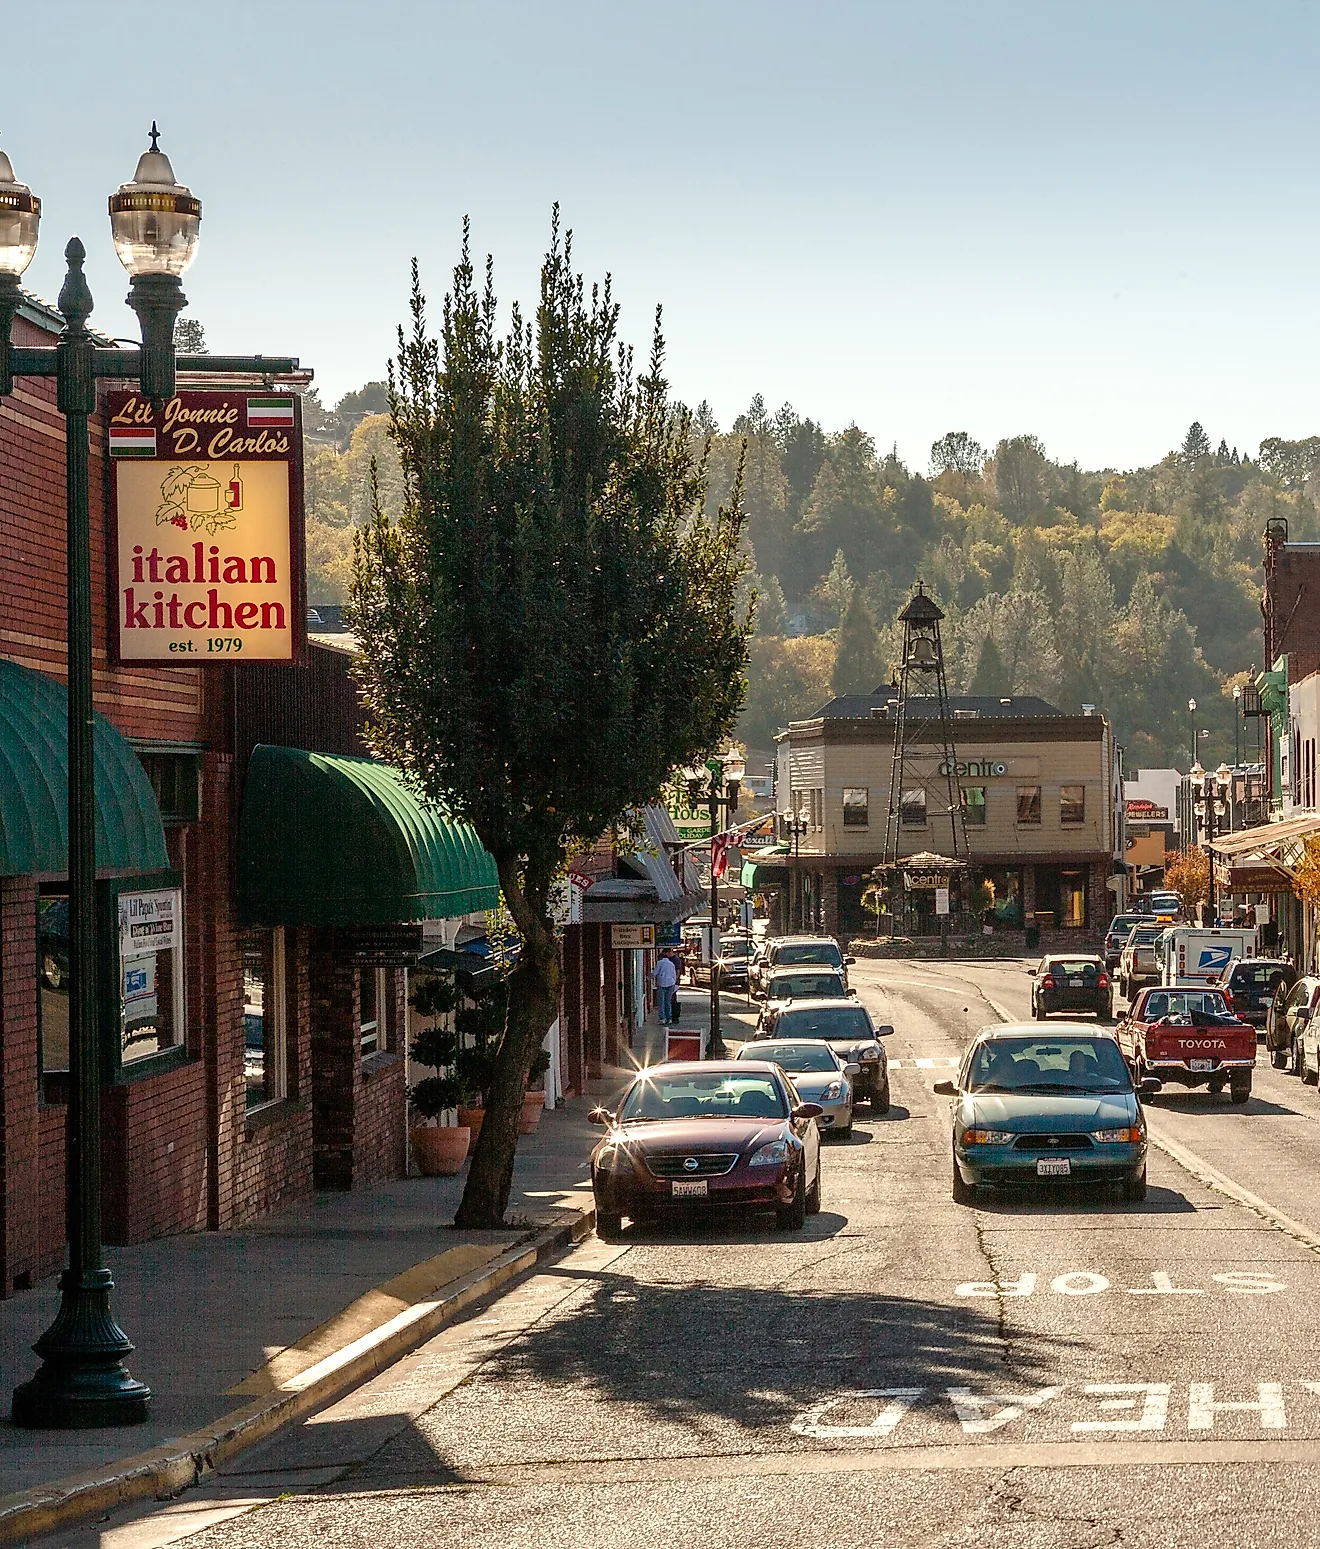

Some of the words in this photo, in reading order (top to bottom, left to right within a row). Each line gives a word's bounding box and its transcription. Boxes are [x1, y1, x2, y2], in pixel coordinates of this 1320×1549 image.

[162, 397, 239, 434] Jonnie
[172, 427, 202, 454] D.
[207, 427, 291, 459] Carlo's
[131, 541, 278, 584] italian
[123, 587, 287, 630] kitchen
[168, 638, 199, 653] est.
[206, 637, 243, 653] 1979
[939, 757, 1009, 778] centro
[911, 875, 949, 885] centro
[1178, 1039, 1227, 1049] TOYOTA
[955, 1271, 1288, 1297] STOP
